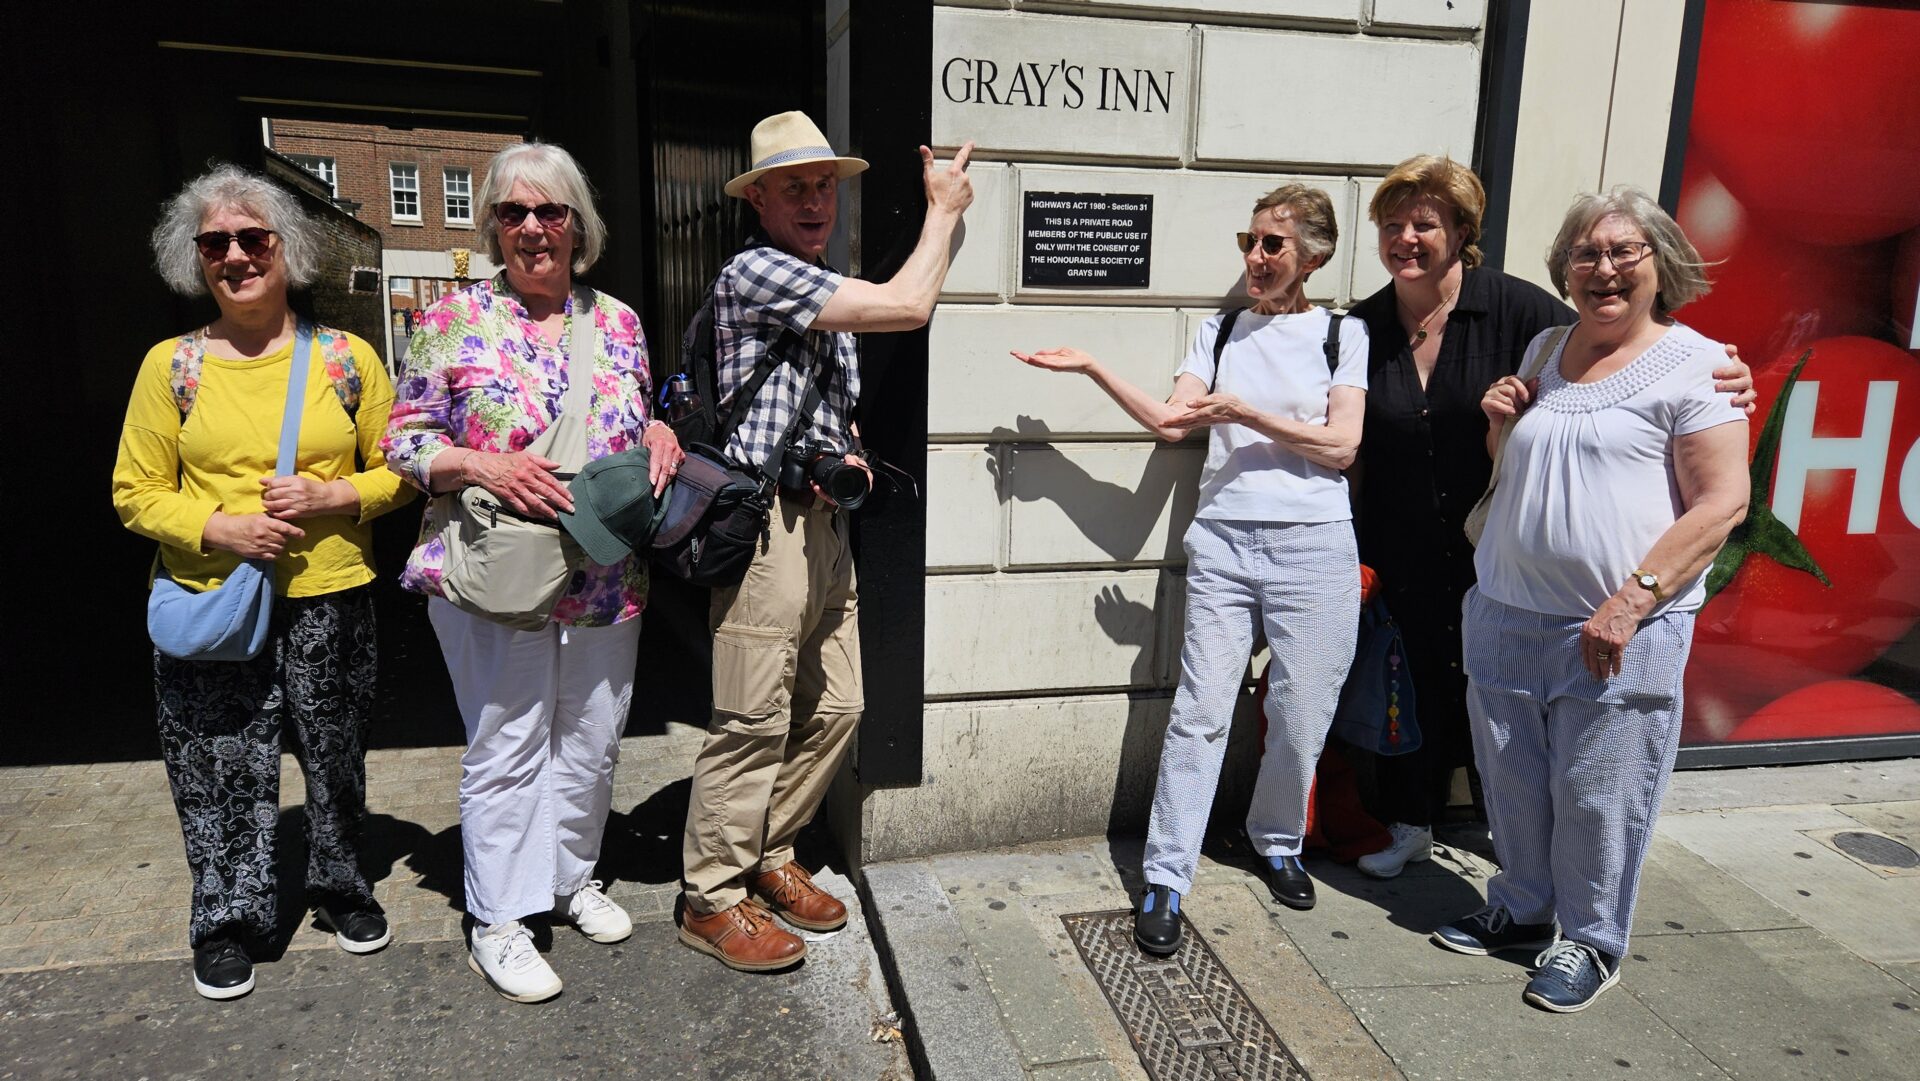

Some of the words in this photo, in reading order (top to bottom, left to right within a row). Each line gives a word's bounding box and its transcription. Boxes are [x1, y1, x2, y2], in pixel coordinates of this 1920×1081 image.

[942, 57, 1084, 109] GRAY'S
[1096, 66, 1175, 113] INN
[1031, 201, 1071, 210] HIGHWAYS
[1072, 202, 1088, 210] ACT
[1089, 202, 1106, 210] 1980
[1111, 203, 1138, 211] Section
[1044, 217, 1062, 226] THIS
[1063, 218, 1071, 226] IS
[1072, 218, 1078, 226] A
[1080, 219, 1111, 227] PRIVATE
[1112, 219, 1133, 227] ROAD
[1028, 230, 1066, 238] MEMBERS
[1079, 231, 1095, 239] THE
[1124, 232, 1140, 240] USE
[1035, 243, 1056, 251] ONLY
[1056, 243, 1077, 251] WITH
[1076, 244, 1091, 252] THE
[1093, 244, 1128, 252] CONSENT
[1047, 256, 1099, 264] HONOURABLE
[1067, 269, 1093, 277] GRAYS
[1771, 380, 1920, 536] H
[1140, 970, 1200, 1040] HYDRANT
[1172, 984, 1212, 1020] FIRE
